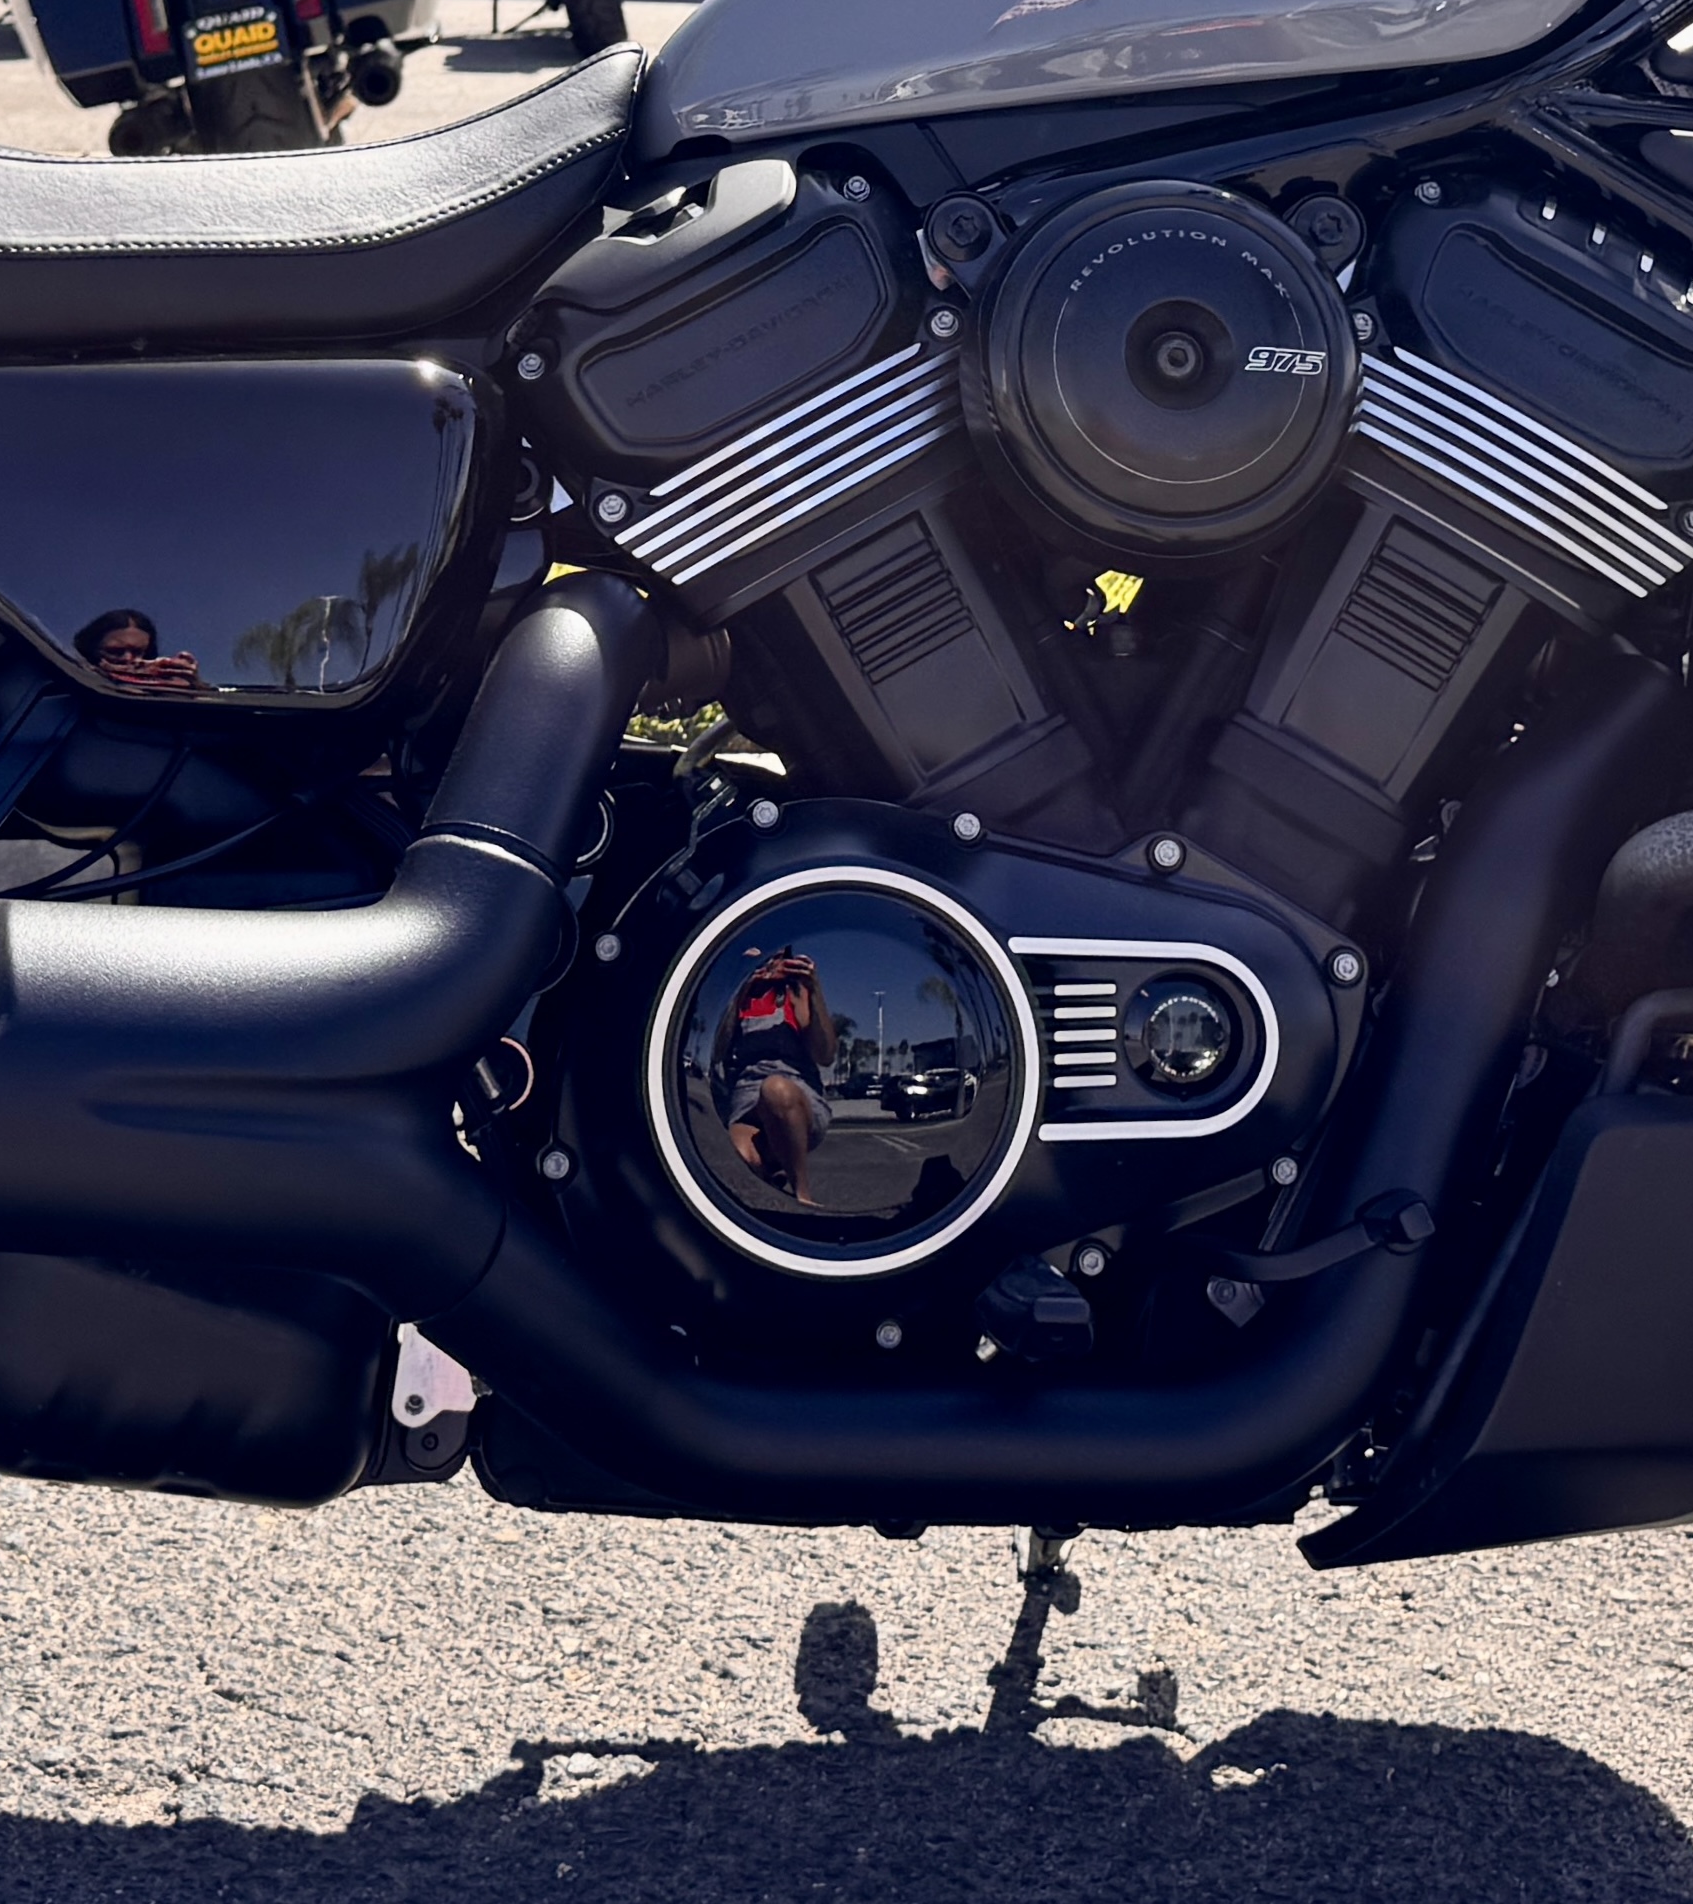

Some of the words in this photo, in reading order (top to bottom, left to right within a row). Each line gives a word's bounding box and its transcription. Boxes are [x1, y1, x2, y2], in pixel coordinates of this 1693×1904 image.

[194, 22, 276, 56] QUAID
[1069, 228, 1228, 293] REVOLUTION
[1240, 250, 1291, 299] MAX
[1244, 345, 1327, 376] 975
